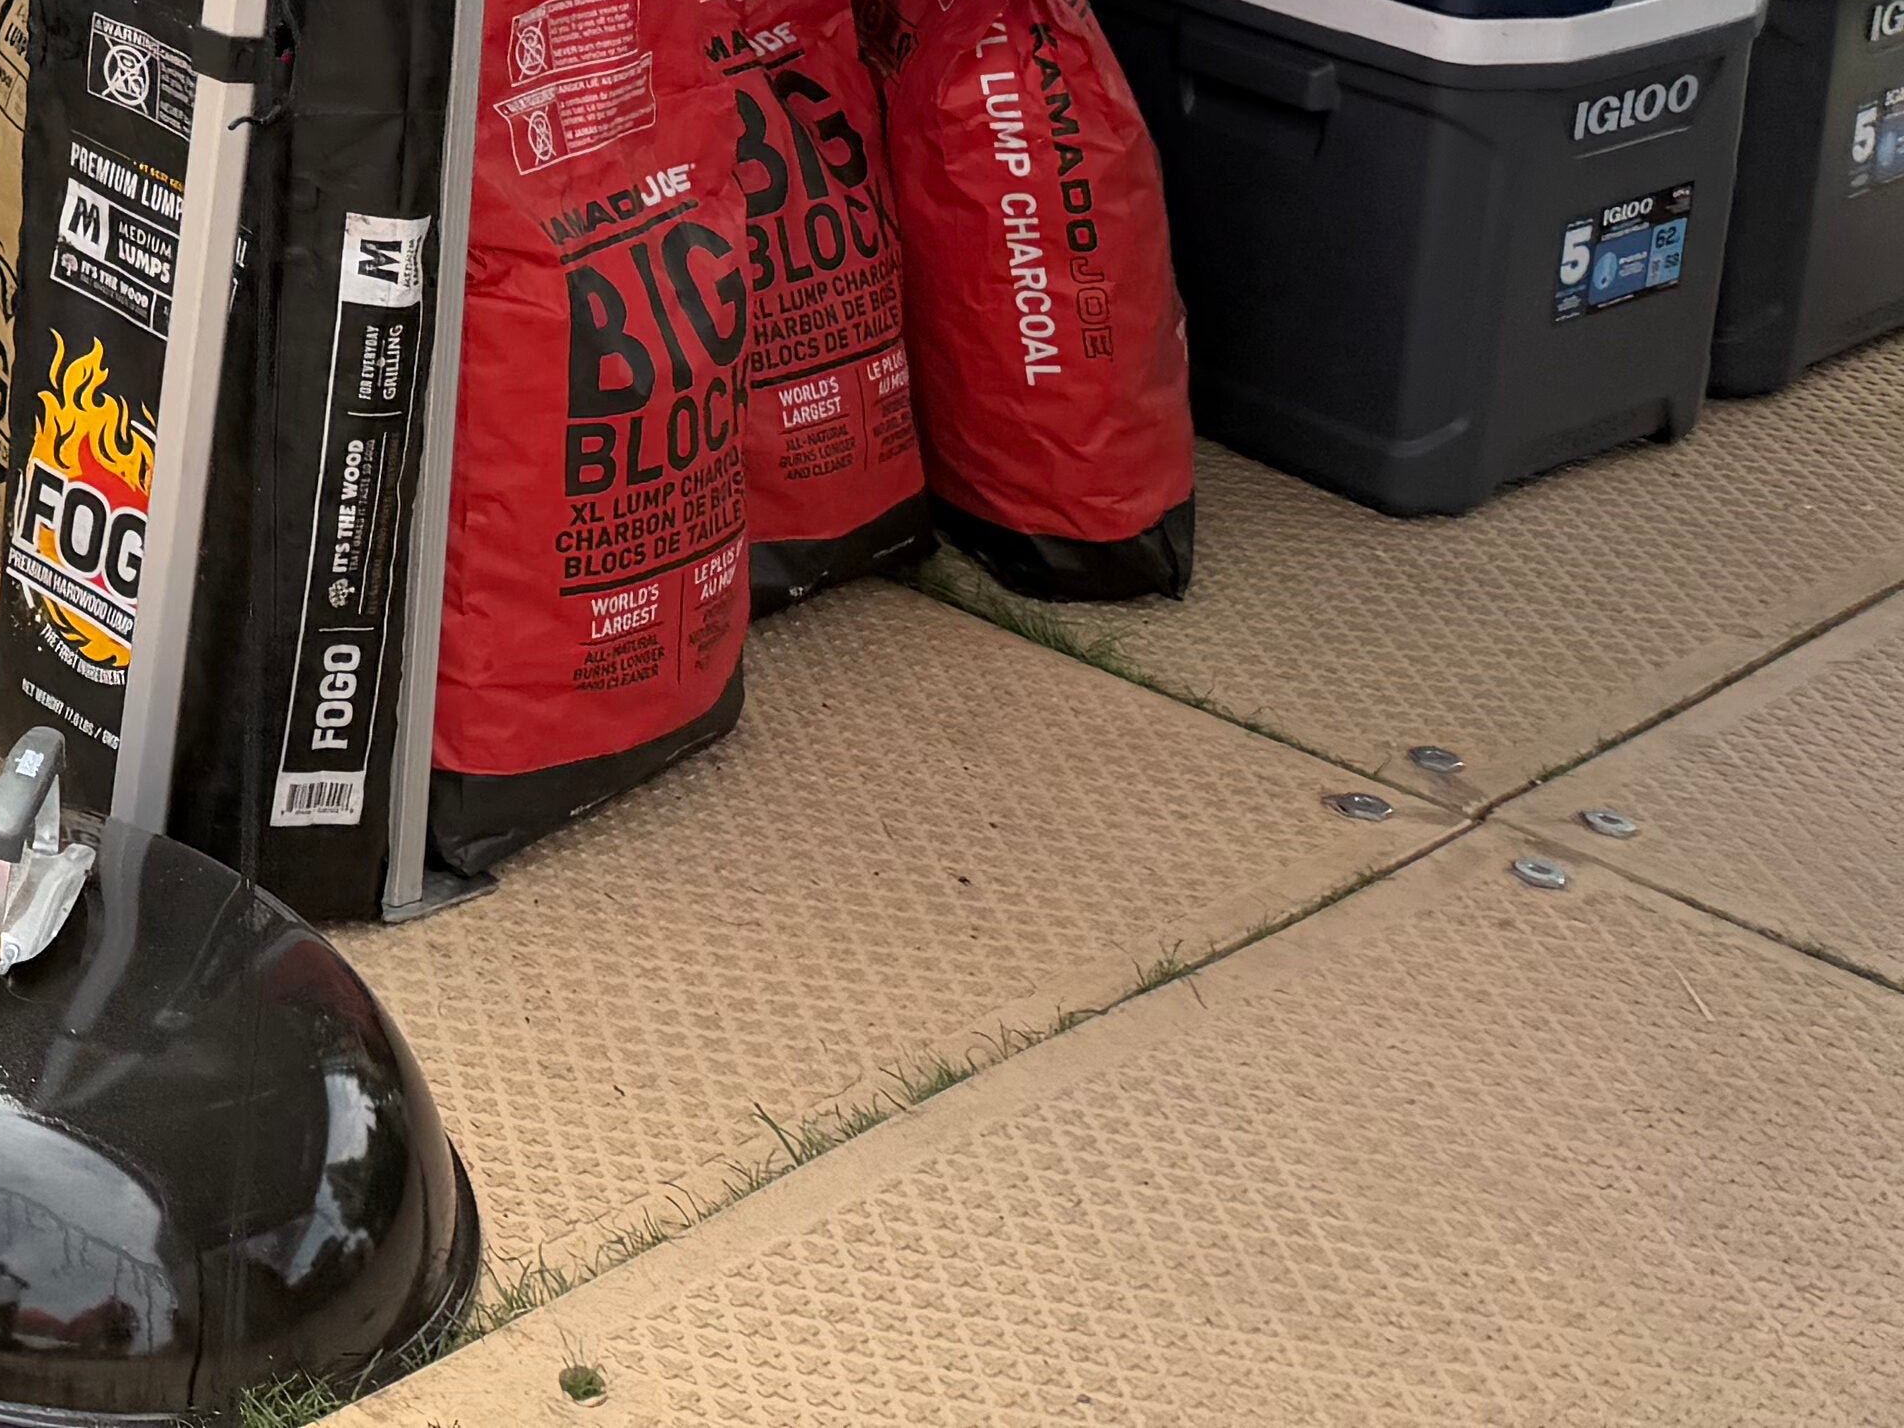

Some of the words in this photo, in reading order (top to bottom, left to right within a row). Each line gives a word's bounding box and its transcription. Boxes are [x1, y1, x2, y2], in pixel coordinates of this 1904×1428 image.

[979, 71, 1031, 178] LUMP
[1574, 74, 1699, 141] IGLOO
[735, 69, 869, 220] BIG
[70, 141, 137, 201] PREMIUM
[141, 175, 185, 223] LUMP
[1603, 197, 1654, 227] IGLOO
[118, 220, 172, 260] MEDIUM
[118, 239, 171, 285] LUMPS
[747, 184, 903, 292] BLOCK
[1560, 225, 1593, 284] 5
[80, 260, 97, 280] IT'S
[98, 268, 118, 291] THE
[118, 278, 149, 309] WOOD
[778, 281, 828, 315] LUMP
[1001, 192, 1062, 387] CHARCOAL
[565, 222, 747, 420] BIG
[751, 337, 821, 373] BLOCS
[824, 328, 850, 351] DE
[854, 304, 901, 344] TAILLE
[753, 305, 839, 346] HARBON
[841, 296, 867, 322] DE
[362, 324, 380, 376] EVERYDAY
[383, 322, 405, 402] GRILLING
[866, 362, 881, 381] LE
[358, 377, 374, 401] FOR
[778, 376, 840, 408] WORLD'S
[782, 396, 842, 429] LARGEST
[341, 439, 364, 502] WOOD
[337, 504, 357, 541] THE
[556, 507, 677, 554] CHARBON
[683, 495, 706, 524] DE
[570, 502, 605, 526] XL
[613, 482, 676, 520] LUMP
[332, 542, 351, 574] IT'S
[565, 542, 647, 580] BLOCS
[654, 531, 681, 559] DE
[687, 500, 742, 546] TAILLE
[9, 547, 54, 585] PREMIUM
[53, 570, 108, 624] HARDWOOD
[106, 606, 134, 637] LUMP
[694, 562, 710, 585] LE
[591, 584, 660, 617] WORLD'S
[591, 603, 659, 640] LARGEST
[41, 623, 59, 650] THE
[57, 641, 80, 672] FIRST
[311, 643, 361, 751] FOGO
